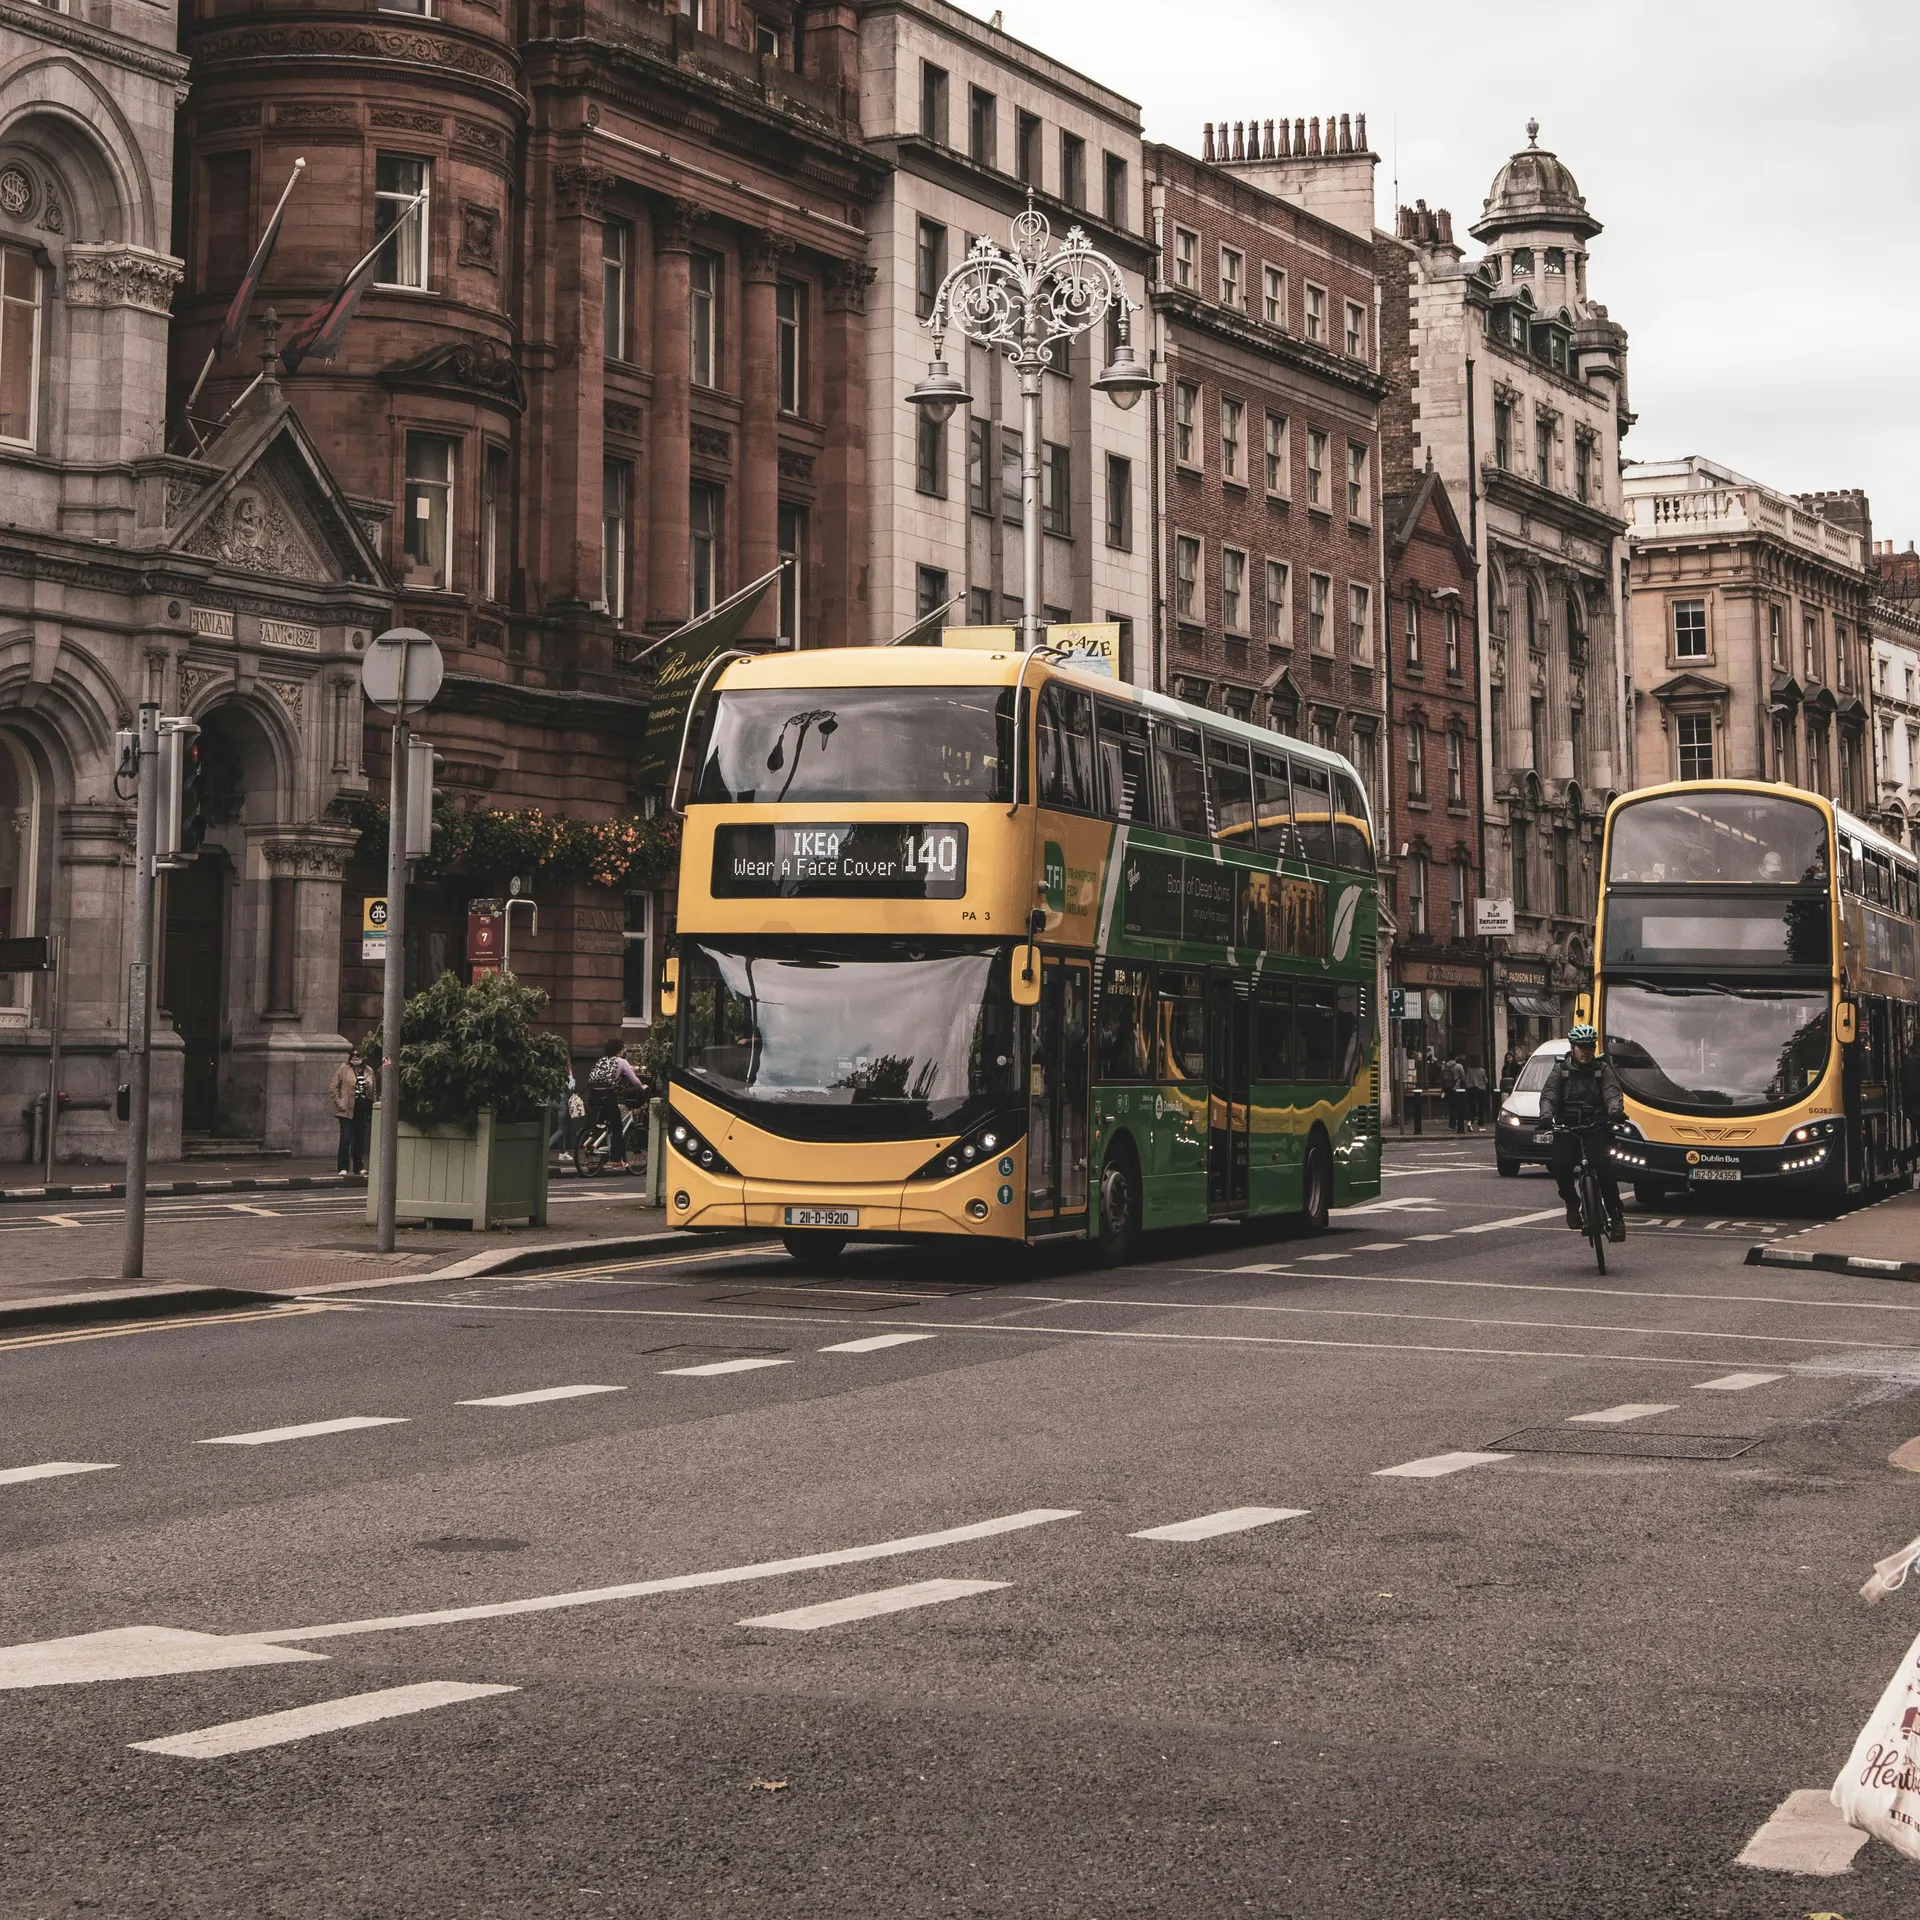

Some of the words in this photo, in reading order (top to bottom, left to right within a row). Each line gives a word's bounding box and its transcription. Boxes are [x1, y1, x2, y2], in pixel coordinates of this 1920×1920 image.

[1056, 635, 1112, 659] GAZE
[793, 832, 839, 856] IKEA
[905, 836, 958, 873] 140
[734, 858, 775, 876] Wear
[781, 858, 791, 876] A
[797, 858, 837, 876] Face
[843, 858, 896, 876] Cover
[1046, 865, 1063, 890] TFI
[1195, 877, 1212, 898] Dead
[1213, 881, 1230, 903] Spins
[962, 912, 977, 921] PA
[985, 912, 991, 921] 3
[481, 932, 488, 942] 7
[1392, 990, 1400, 1003] P
[1700, 1154, 1724, 1163] Dublin
[1725, 1155, 1740, 1163] Bus
[1694, 1170, 1737, 1180] 162-D-24356
[799, 1211, 849, 1225] 211-D-19210
